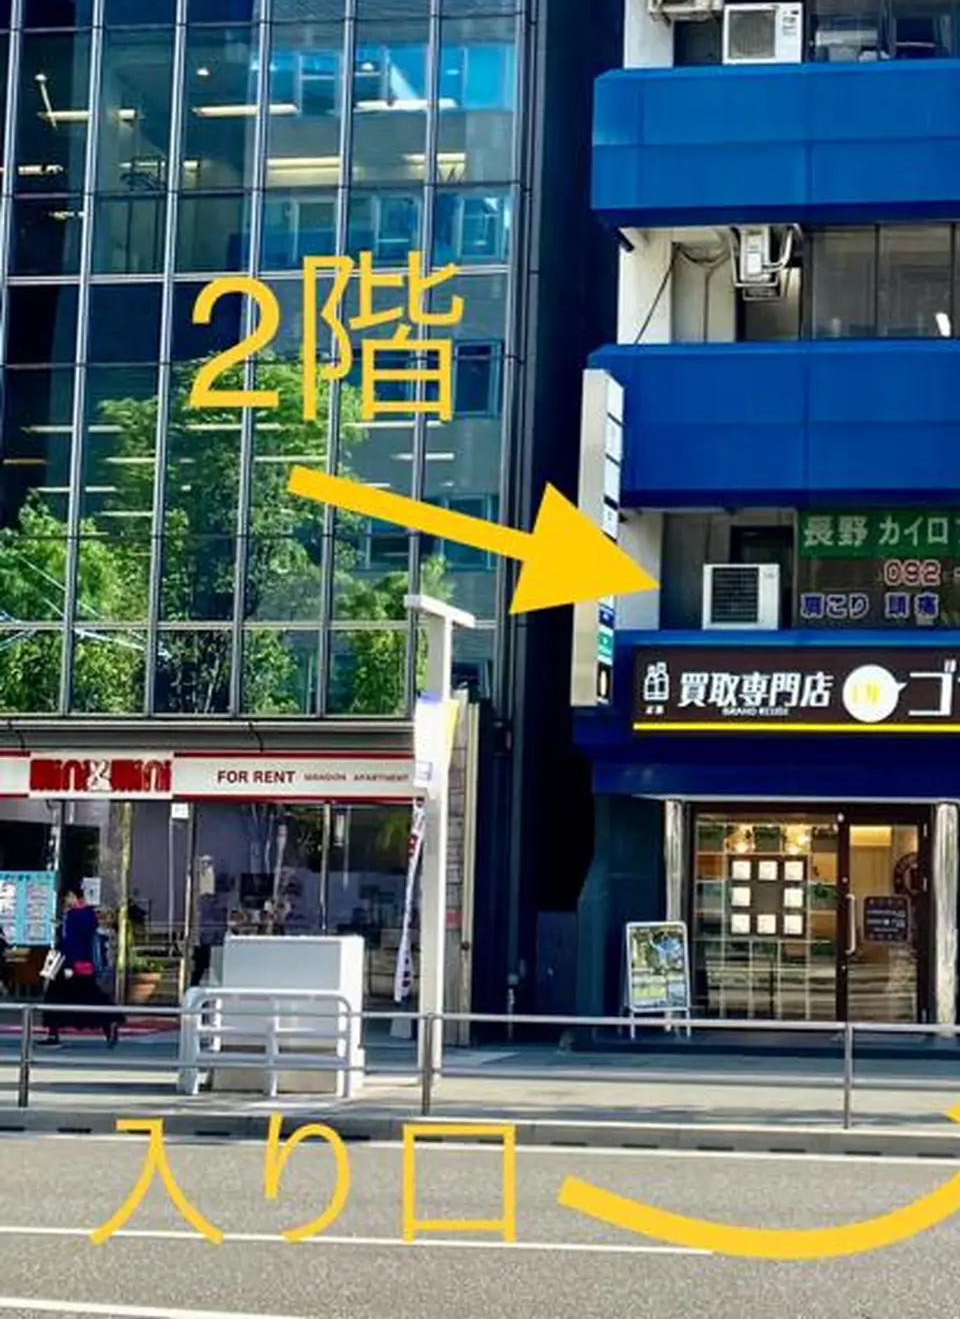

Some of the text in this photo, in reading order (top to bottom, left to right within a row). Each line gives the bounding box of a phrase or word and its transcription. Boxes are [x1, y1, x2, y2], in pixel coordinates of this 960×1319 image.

[803, 515, 868, 547] 長野
[677, 671, 834, 708] 買取専門店
[217, 770, 248, 783] FOR
[252, 770, 296, 783] RENT
